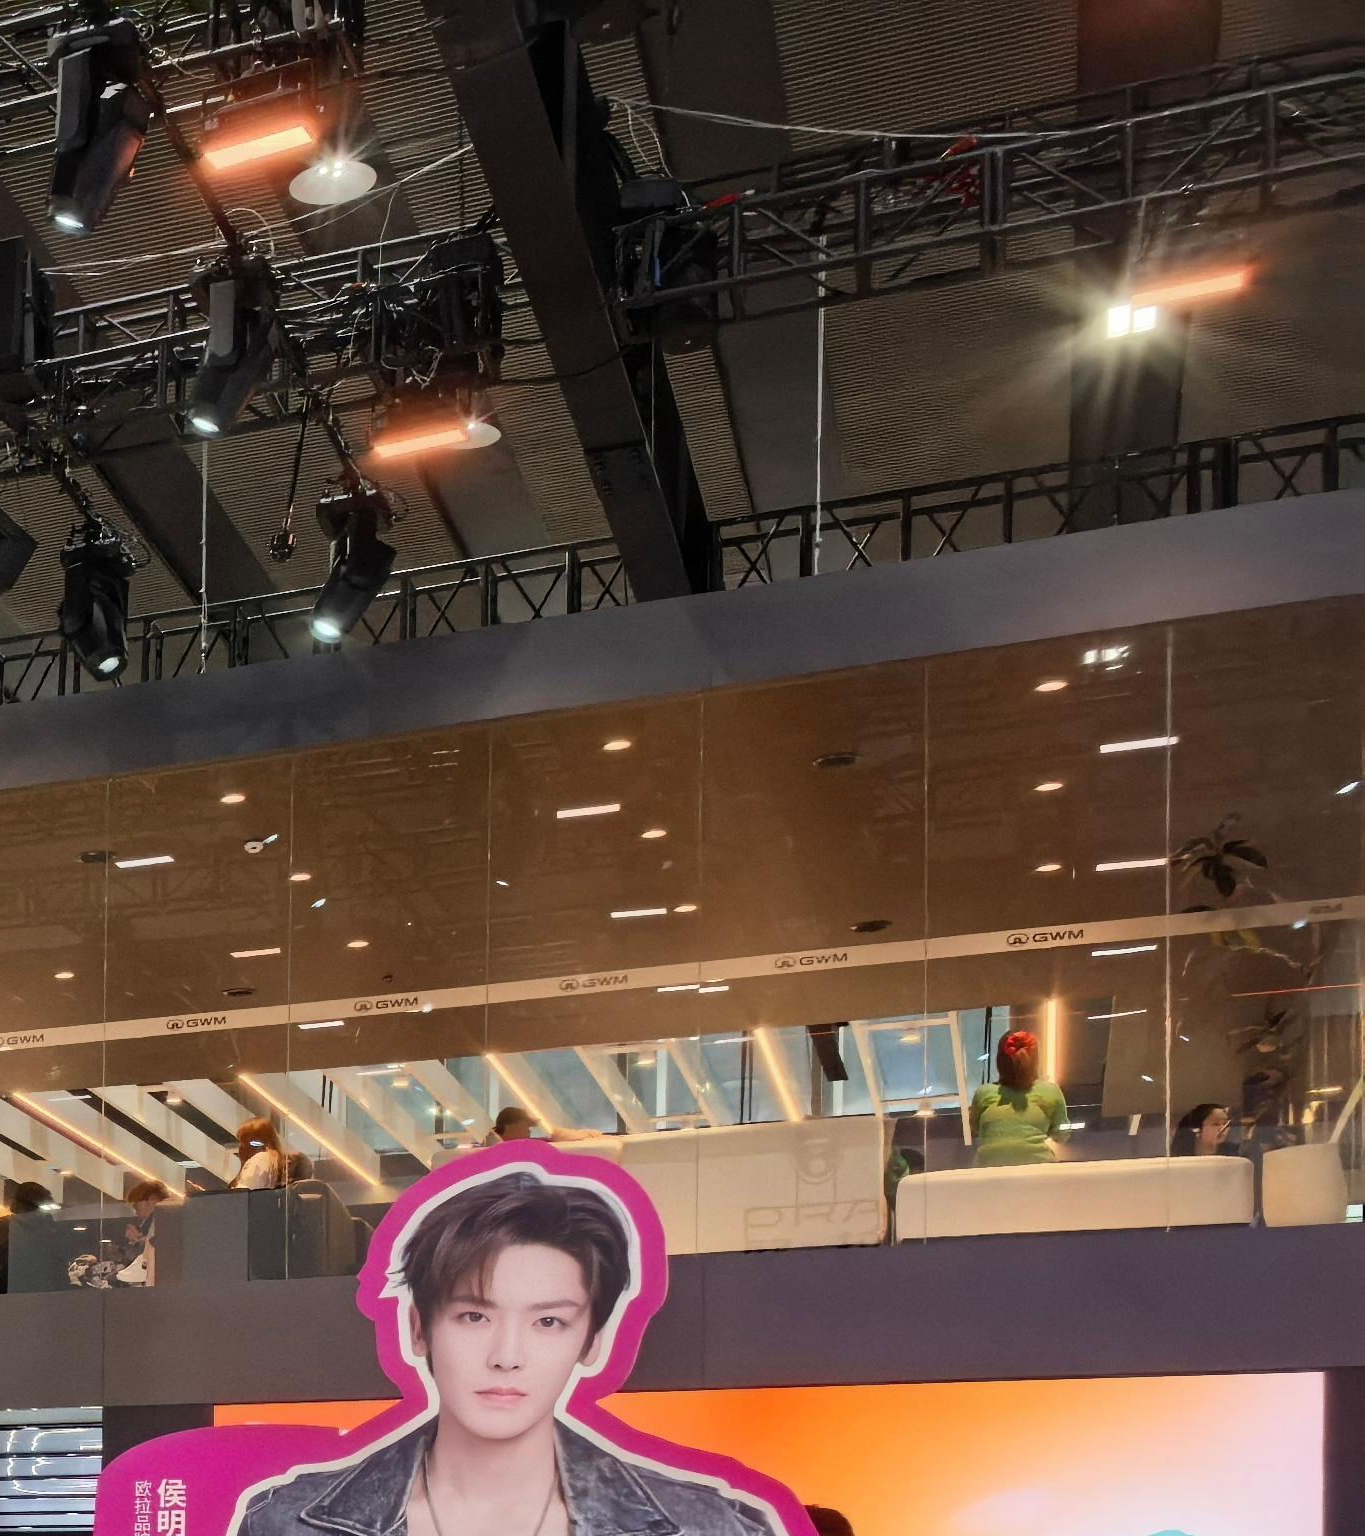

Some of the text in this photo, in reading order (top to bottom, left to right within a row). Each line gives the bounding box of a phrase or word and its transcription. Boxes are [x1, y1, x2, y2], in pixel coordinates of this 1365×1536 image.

[1032, 929, 1084, 944] GWM
[799, 953, 850, 967] GWM
[581, 974, 629, 989] GWM
[375, 997, 419, 1010] GWM
[186, 1016, 227, 1028] GWM
[6, 1033, 45, 1046] GWM
